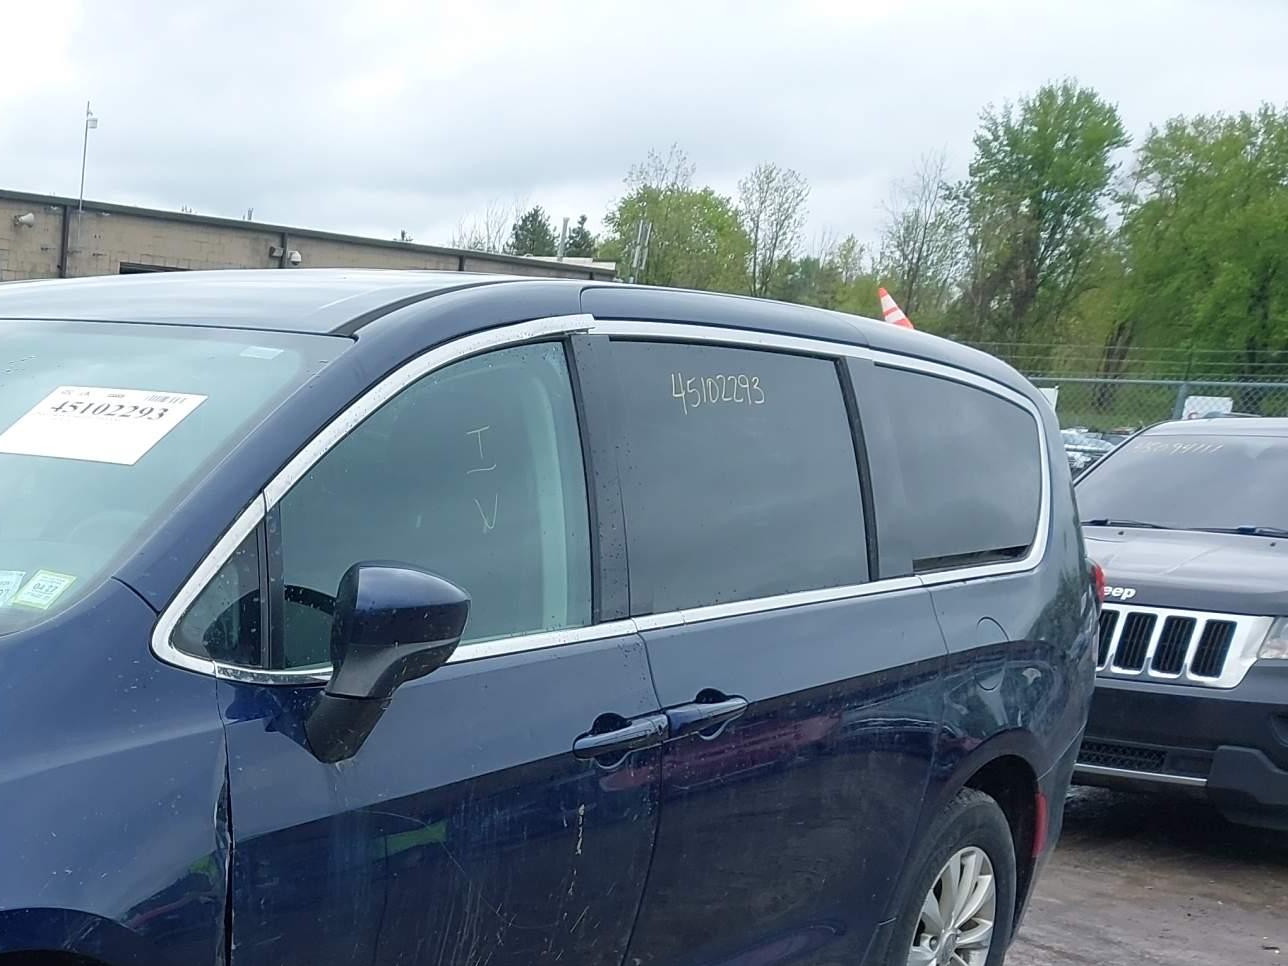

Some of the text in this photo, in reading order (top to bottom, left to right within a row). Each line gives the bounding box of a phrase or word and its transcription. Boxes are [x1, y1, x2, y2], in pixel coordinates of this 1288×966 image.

[671, 372, 766, 415] 45102293
[50, 400, 169, 420] 45102293
[1103, 585, 1137, 600] eep
